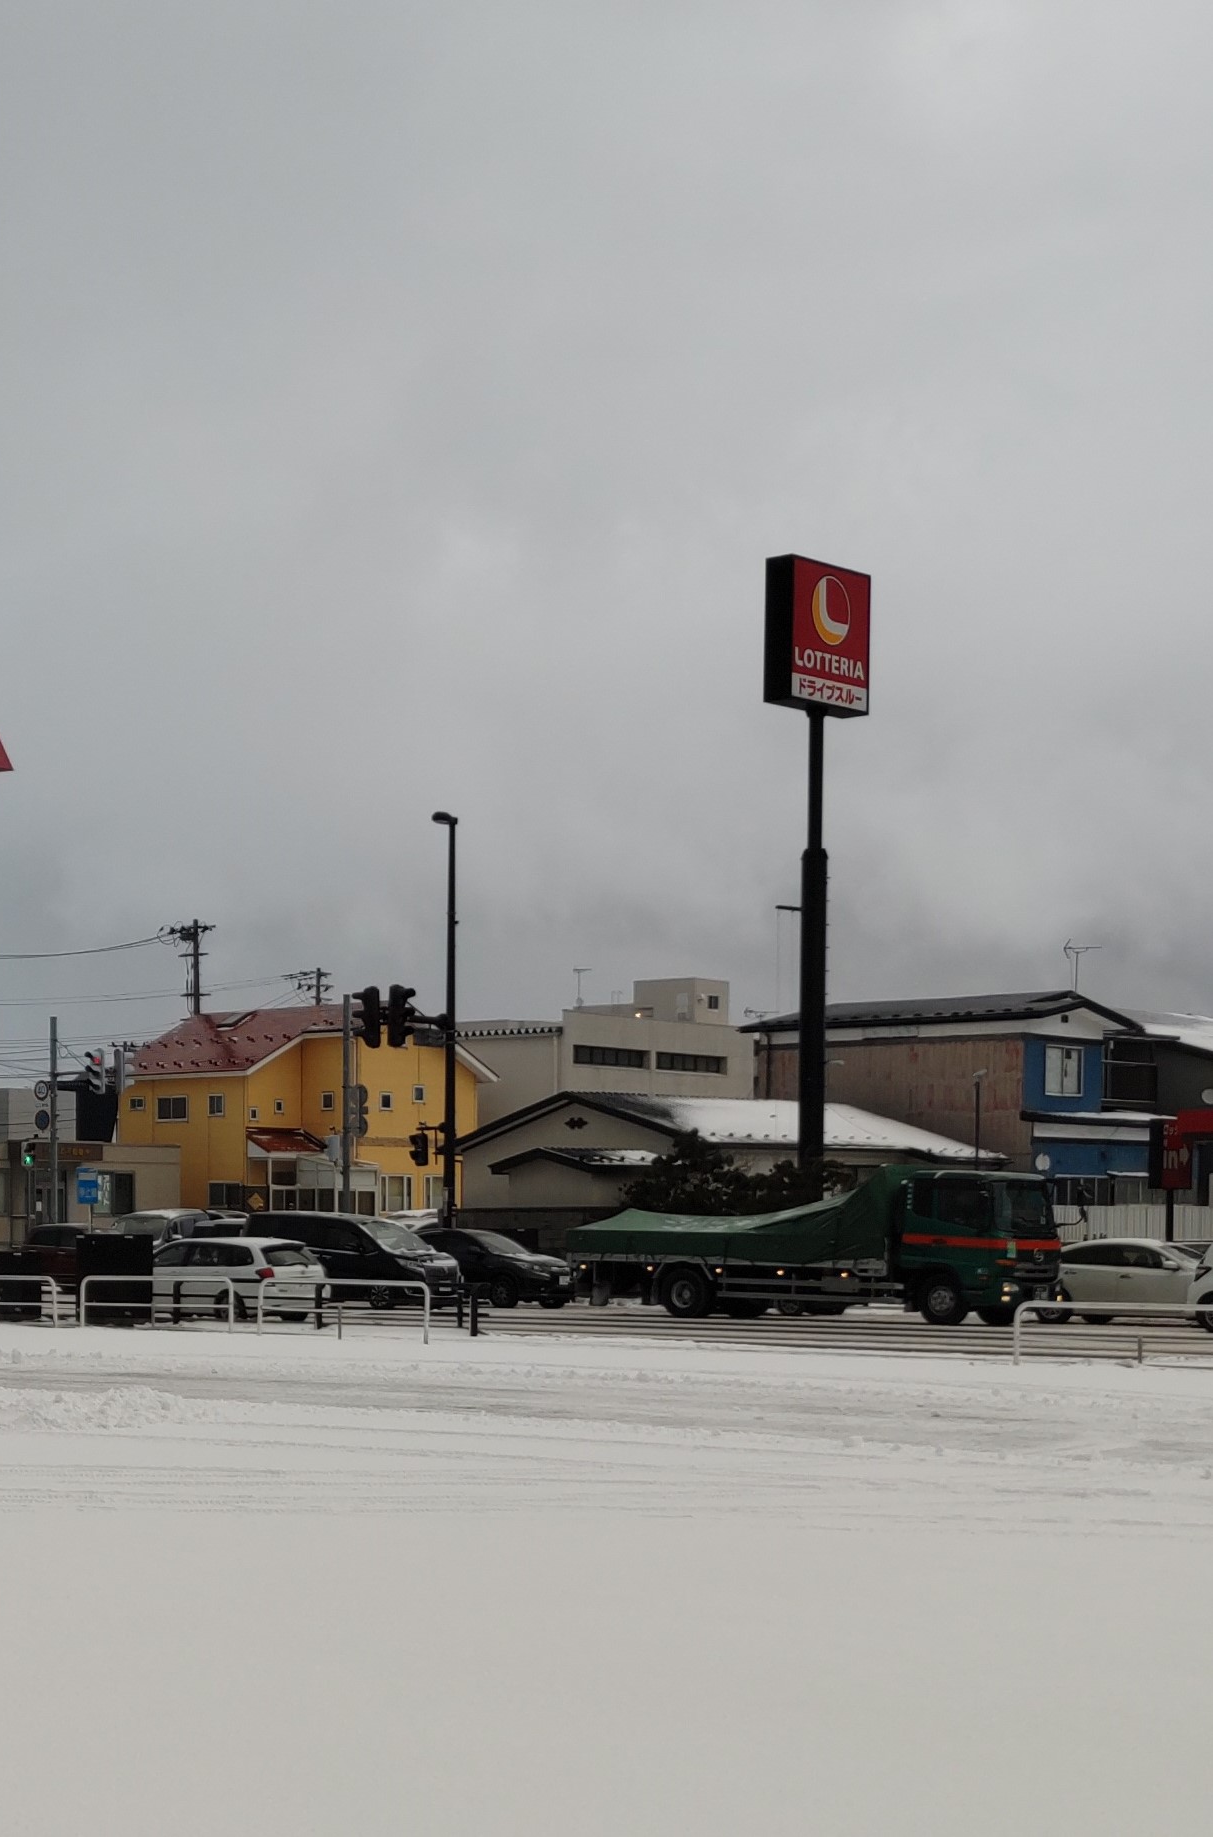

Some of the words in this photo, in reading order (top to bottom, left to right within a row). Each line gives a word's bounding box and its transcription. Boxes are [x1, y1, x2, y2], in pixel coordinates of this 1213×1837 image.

[795, 646, 864, 681] LOTTERIA
[799, 678, 862, 705] ドライブスルー
